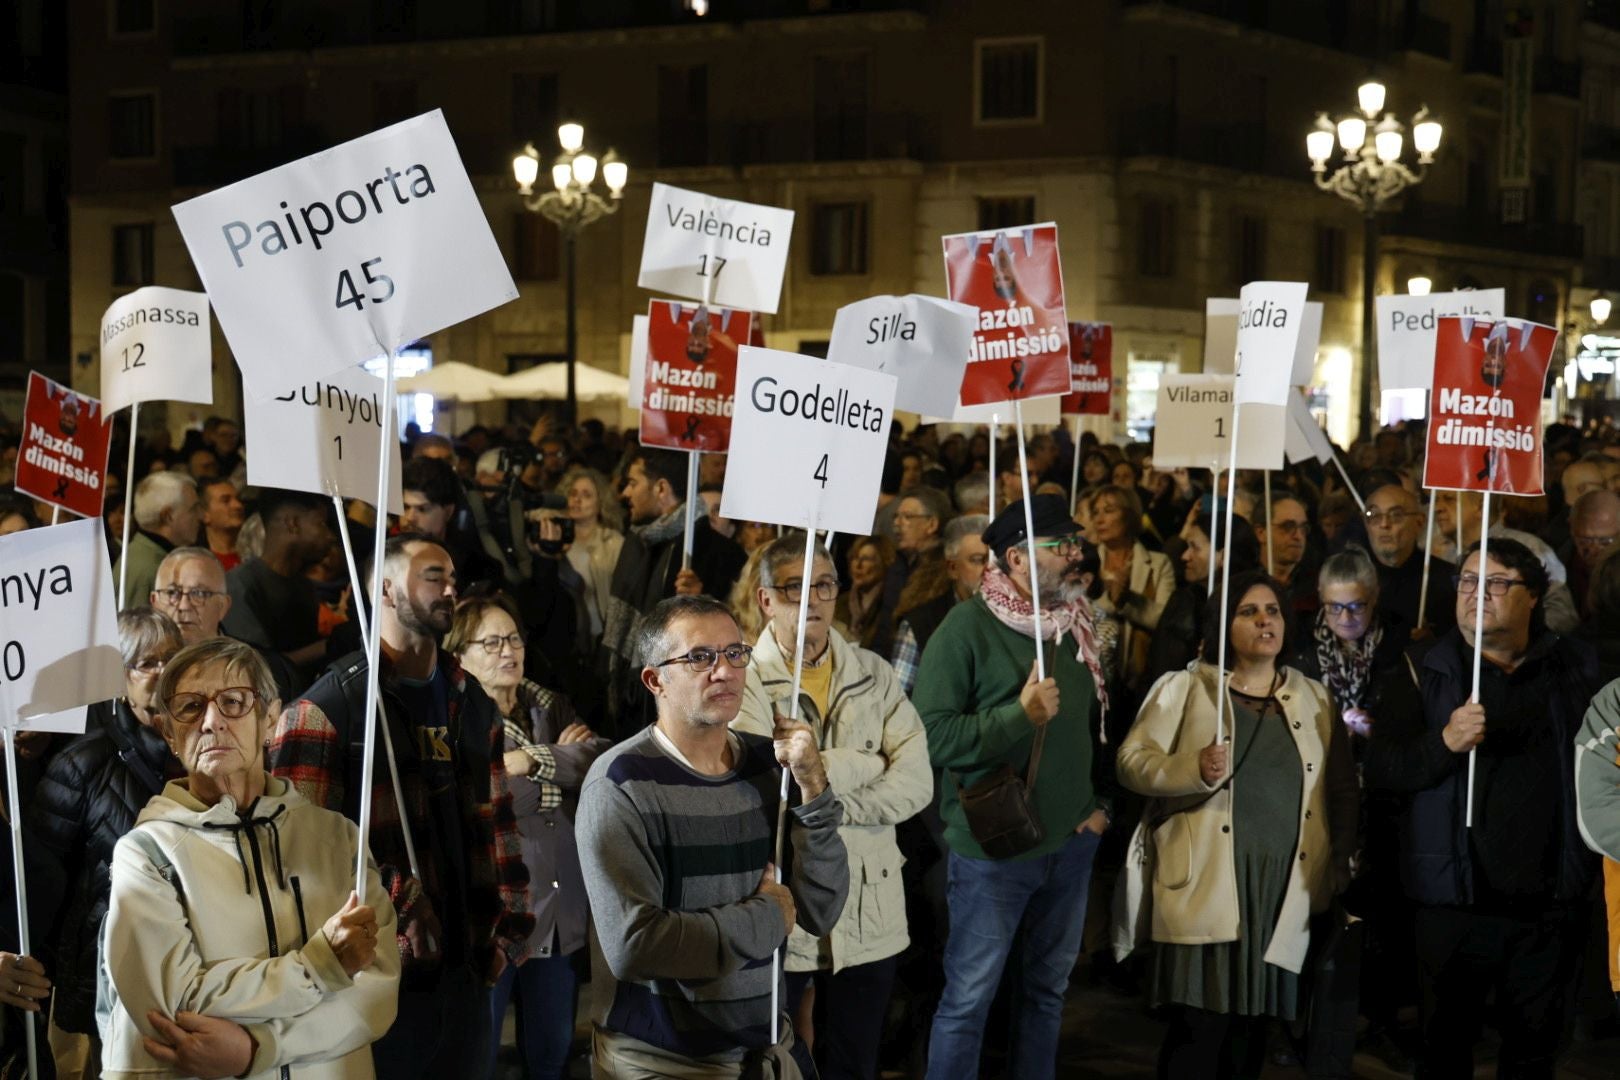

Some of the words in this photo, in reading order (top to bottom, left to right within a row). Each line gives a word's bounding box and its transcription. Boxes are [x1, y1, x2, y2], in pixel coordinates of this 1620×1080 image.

[221, 163, 436, 268] Paiporta
[667, 203, 771, 247] València
[335, 256, 395, 311] 45
[696, 253, 727, 279] 17
[102, 306, 199, 345] Massanassa
[866, 313, 917, 345] Silla
[974, 300, 1035, 331] azón
[121, 342, 147, 373] 12
[967, 325, 1061, 362] dimissió
[651, 360, 717, 390] Mazón
[274, 381, 383, 427] unyol
[648, 387, 735, 418] dimissió
[751, 376, 883, 433] Godelleta
[1440, 387, 1515, 418] Mazón
[30, 422, 84, 462] Mazón
[1214, 417, 1227, 438] 1
[1437, 419, 1534, 452] dimissió
[334, 435, 343, 460] 1
[25, 445, 99, 489] dimissió
[813, 453, 829, 489] 4
[0, 640, 25, 684] 0
